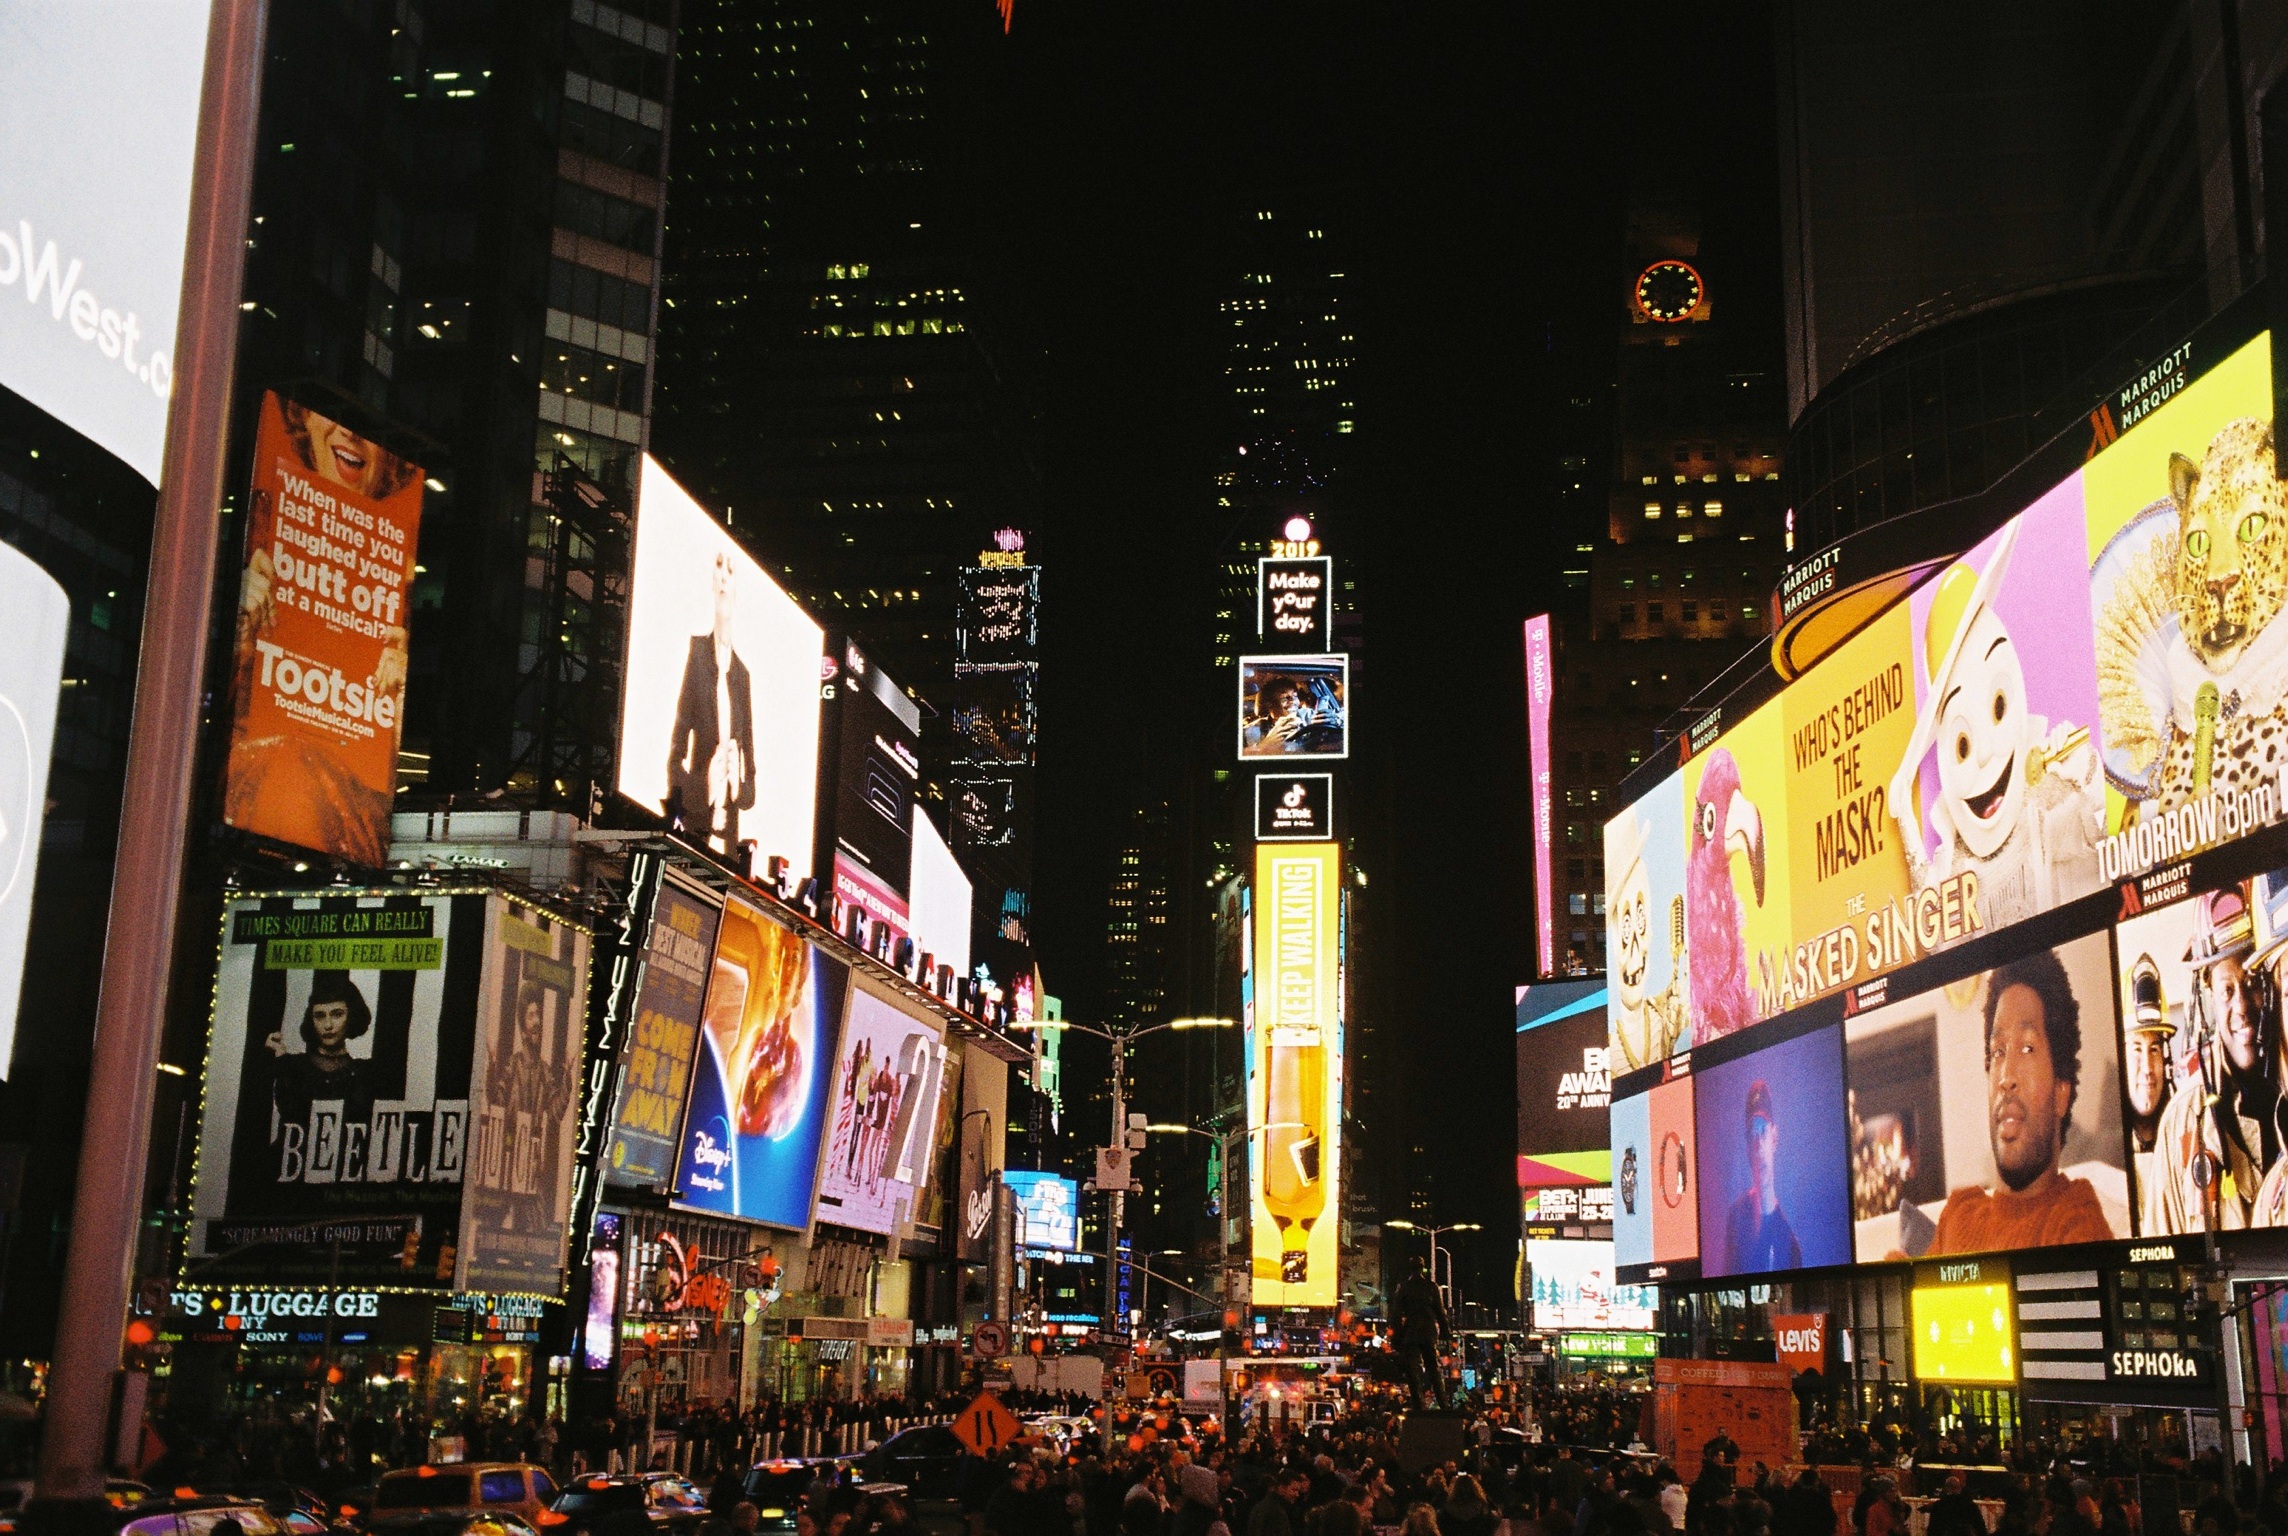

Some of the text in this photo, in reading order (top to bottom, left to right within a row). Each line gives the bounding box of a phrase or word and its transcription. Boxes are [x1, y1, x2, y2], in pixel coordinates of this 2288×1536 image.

[2121, 342, 2192, 407] MARRIOTT
[2122, 372, 2184, 429] MARQUIS
[279, 492, 403, 566] last time you
[341, 502, 374, 530] was
[378, 517, 405, 544] the
[276, 516, 401, 587] laughed your
[1273, 542, 1320, 558] 2019
[273, 541, 400, 623] butt off
[1269, 572, 1320, 589] Make
[1783, 547, 1841, 596] MARRIOTT
[276, 586, 295, 606] at
[299, 595, 310, 611] a
[1273, 593, 1317, 613] your
[1784, 573, 1832, 616] MARQUIS
[1275, 614, 1314, 632] day.
[256, 639, 395, 728] Tootsie
[274, 693, 374, 737] TootsieMusical.com
[1793, 664, 1904, 773] WHO'S BEHIND
[1833, 744, 1862, 800] THE
[1815, 785, 1885, 883] MASK?
[2096, 783, 2274, 883] TOMORROW 8pm
[453, 854, 507, 868] LAMAR
[2142, 862, 2193, 891] MARRIOTT
[1846, 893, 1866, 918] THE
[2143, 882, 2187, 906] MARQUIS
[240, 910, 428, 937] TIMES SQUARE CAN REALLY
[1281, 866, 1313, 967] WALKING
[271, 943, 437, 964] MAKE YOU FEEL ALIVE!
[1758, 868, 1982, 1016] MASKED SINGER
[1281, 971, 1313, 1024] KEEP
[637, 1009, 694, 1062] COME
[619, 1089, 682, 1136] AWAY
[1557, 1095, 1578, 1109] 20TH
[277, 1106, 466, 1183] BEETLE
[324, 1225, 360, 1243] GOOD
[2130, 1246, 2174, 1262] SEPHORA
[1940, 1263, 1981, 1282] INVICTA
[227, 1293, 379, 1317] LUGGAGE
[246, 1332, 288, 1342] SONY
[2113, 1352, 2197, 1377] SEPHORA
